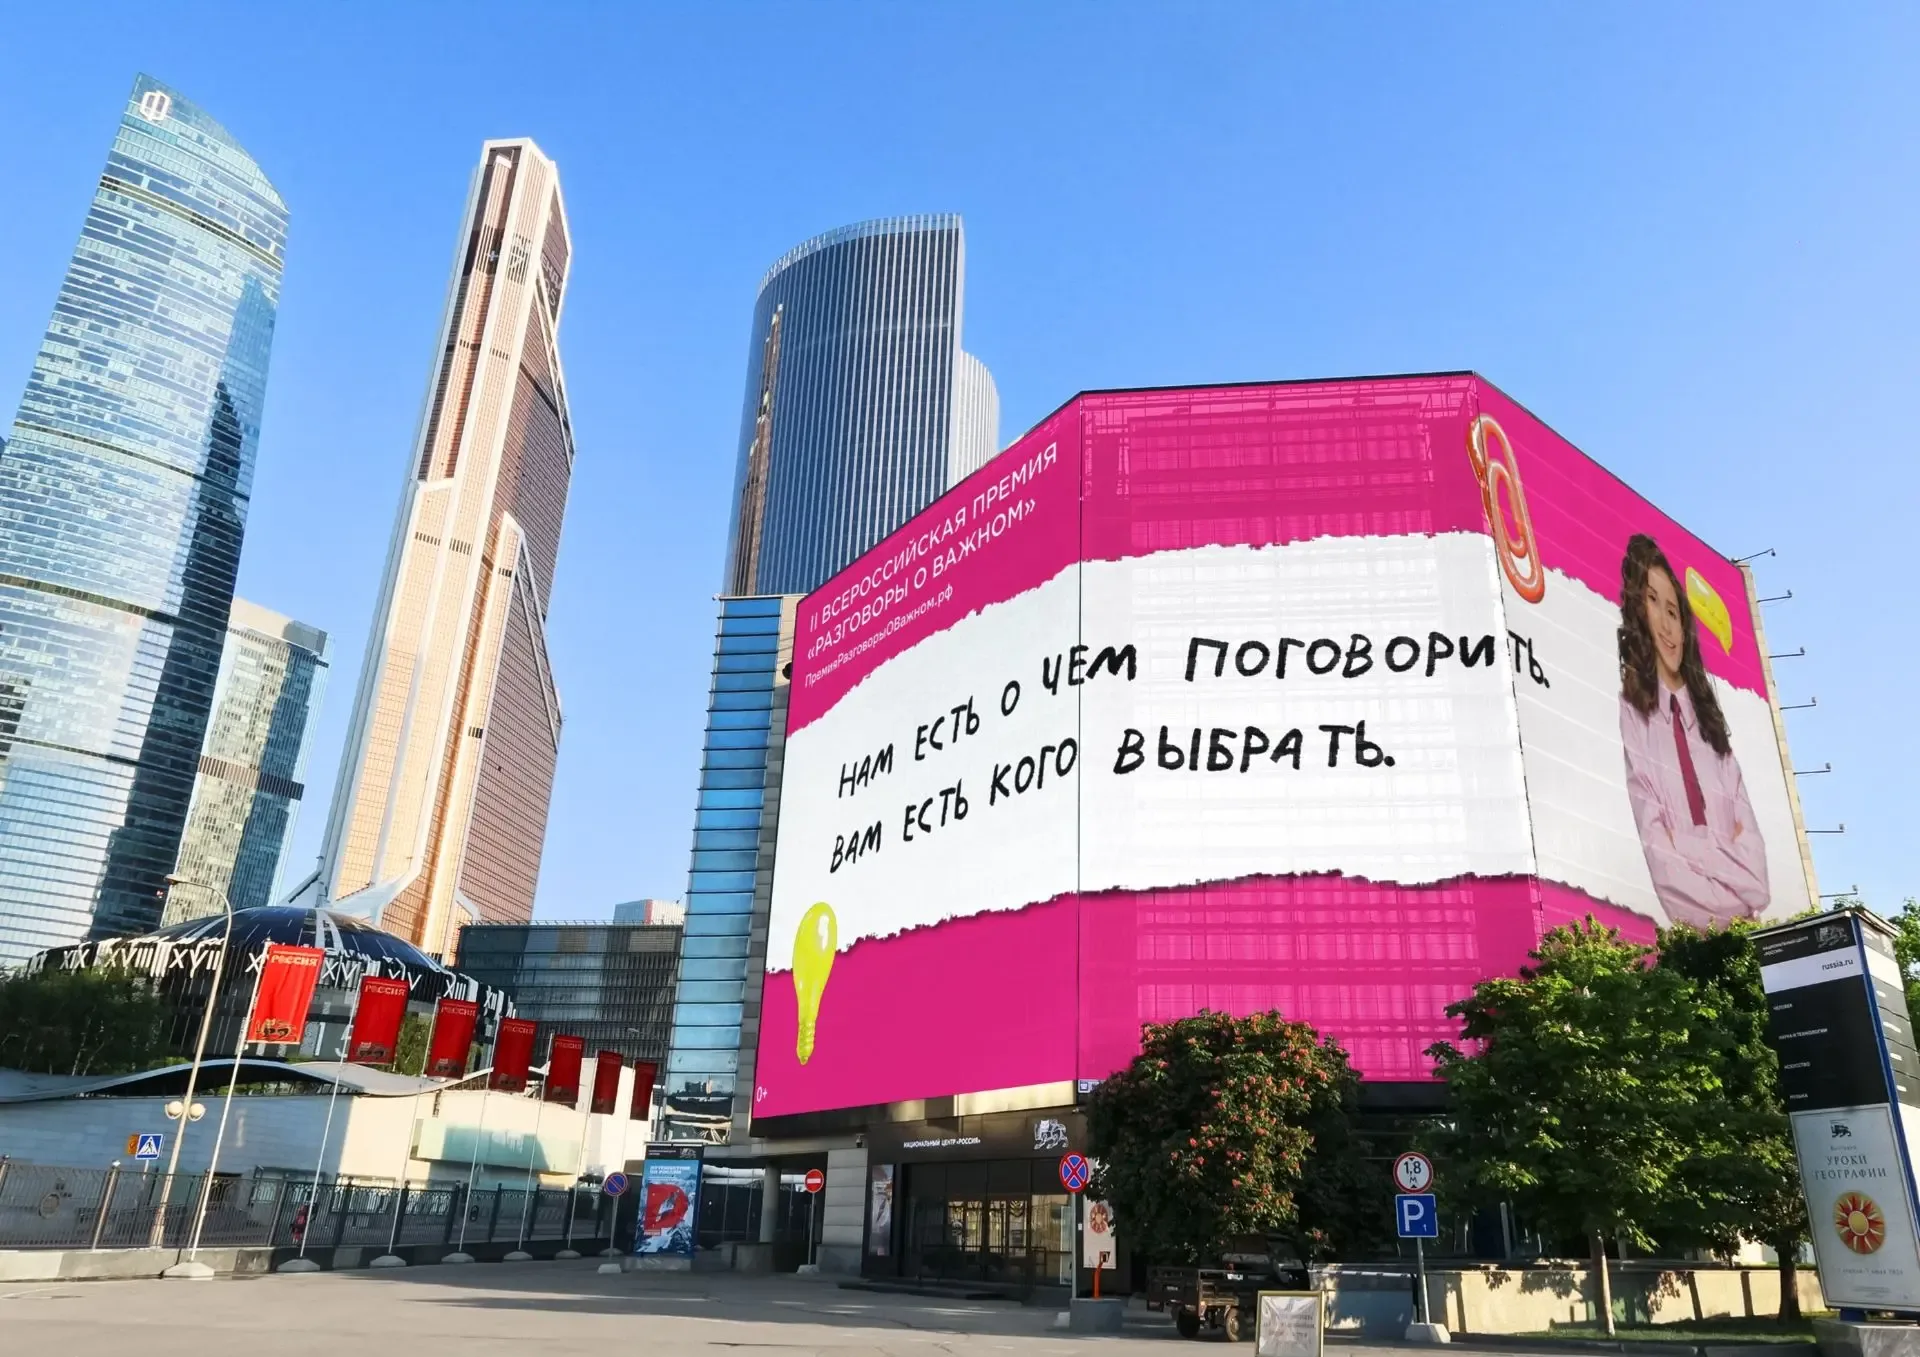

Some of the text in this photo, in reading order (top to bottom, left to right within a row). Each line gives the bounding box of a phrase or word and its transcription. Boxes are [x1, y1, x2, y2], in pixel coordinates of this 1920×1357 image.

[809, 441, 1057, 633] II ВСЕРОССИЙСКАЯ ПРЕМИЯ
[807, 498, 1036, 660] «РАЗГОВОРЫ О ВАЖНОМ»
[804, 583, 953, 688] ПремияРазговорыОВажном.рф
[838, 630, 1551, 798] НАМ ЕСТЬ О ЧЕМ ПОГОВОРИТЬ.
[829, 719, 1396, 874] ВАМ ЕСТЬ КОГО ВЫБРАТЬ.
[270, 954, 319, 967] РОССИЯ
[1821, 958, 1854, 971] russia.ru
[364, 984, 407, 997] РОССИЯ
[756, 1086, 768, 1102] 0+
[1404, 1160, 1422, 1176] 1,8
[1825, 1154, 1868, 1166] УРОКИ
[1814, 1167, 1887, 1181] ГЕОГРАФИИ
[1403, 1199, 1425, 1232] P
